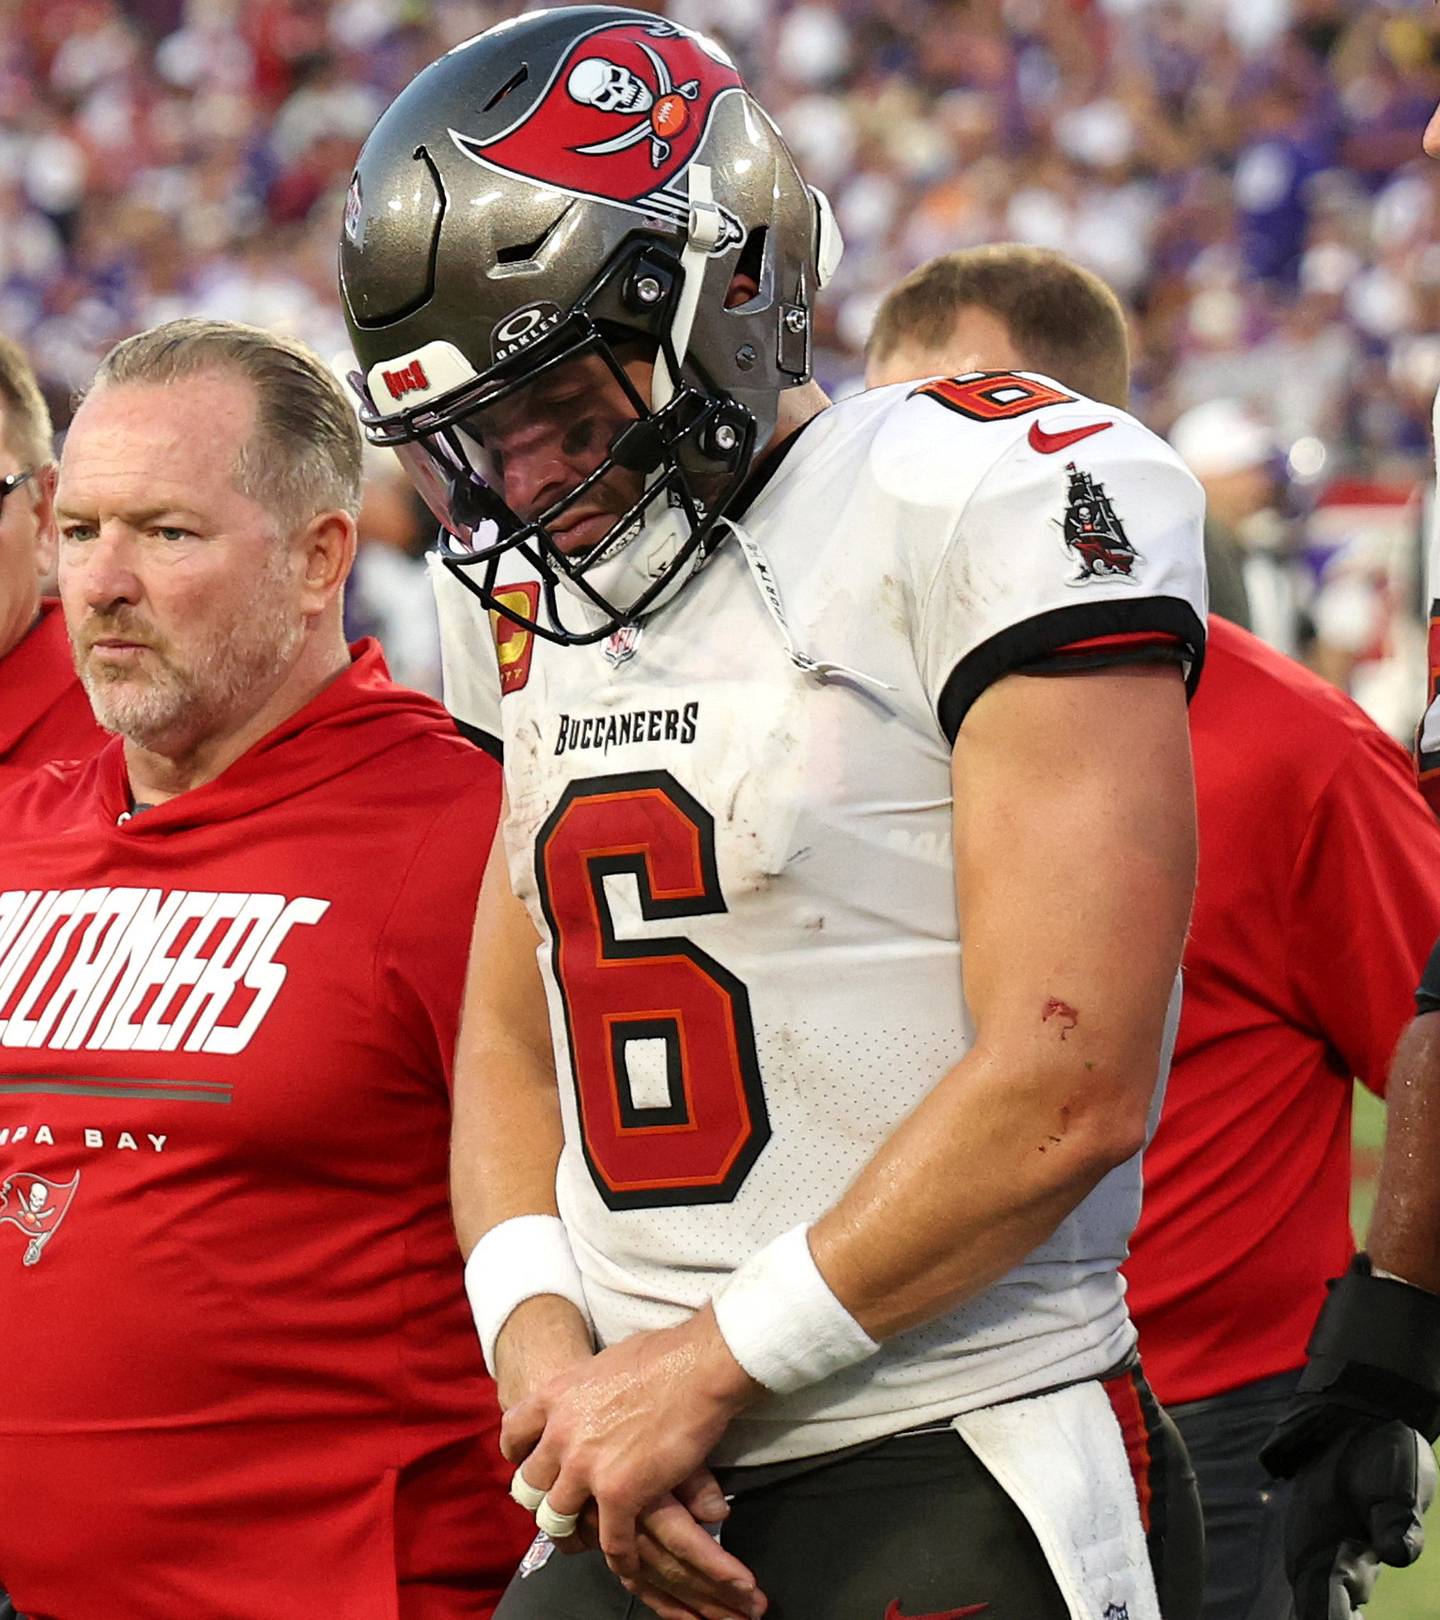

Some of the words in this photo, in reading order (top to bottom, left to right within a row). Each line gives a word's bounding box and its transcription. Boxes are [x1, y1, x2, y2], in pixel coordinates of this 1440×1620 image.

[496, 312, 559, 360] OAKLEY
[554, 702, 699, 757] BUCCANEERS
[534, 769, 773, 1211] 6
[84, 1128, 168, 1153] BAY
